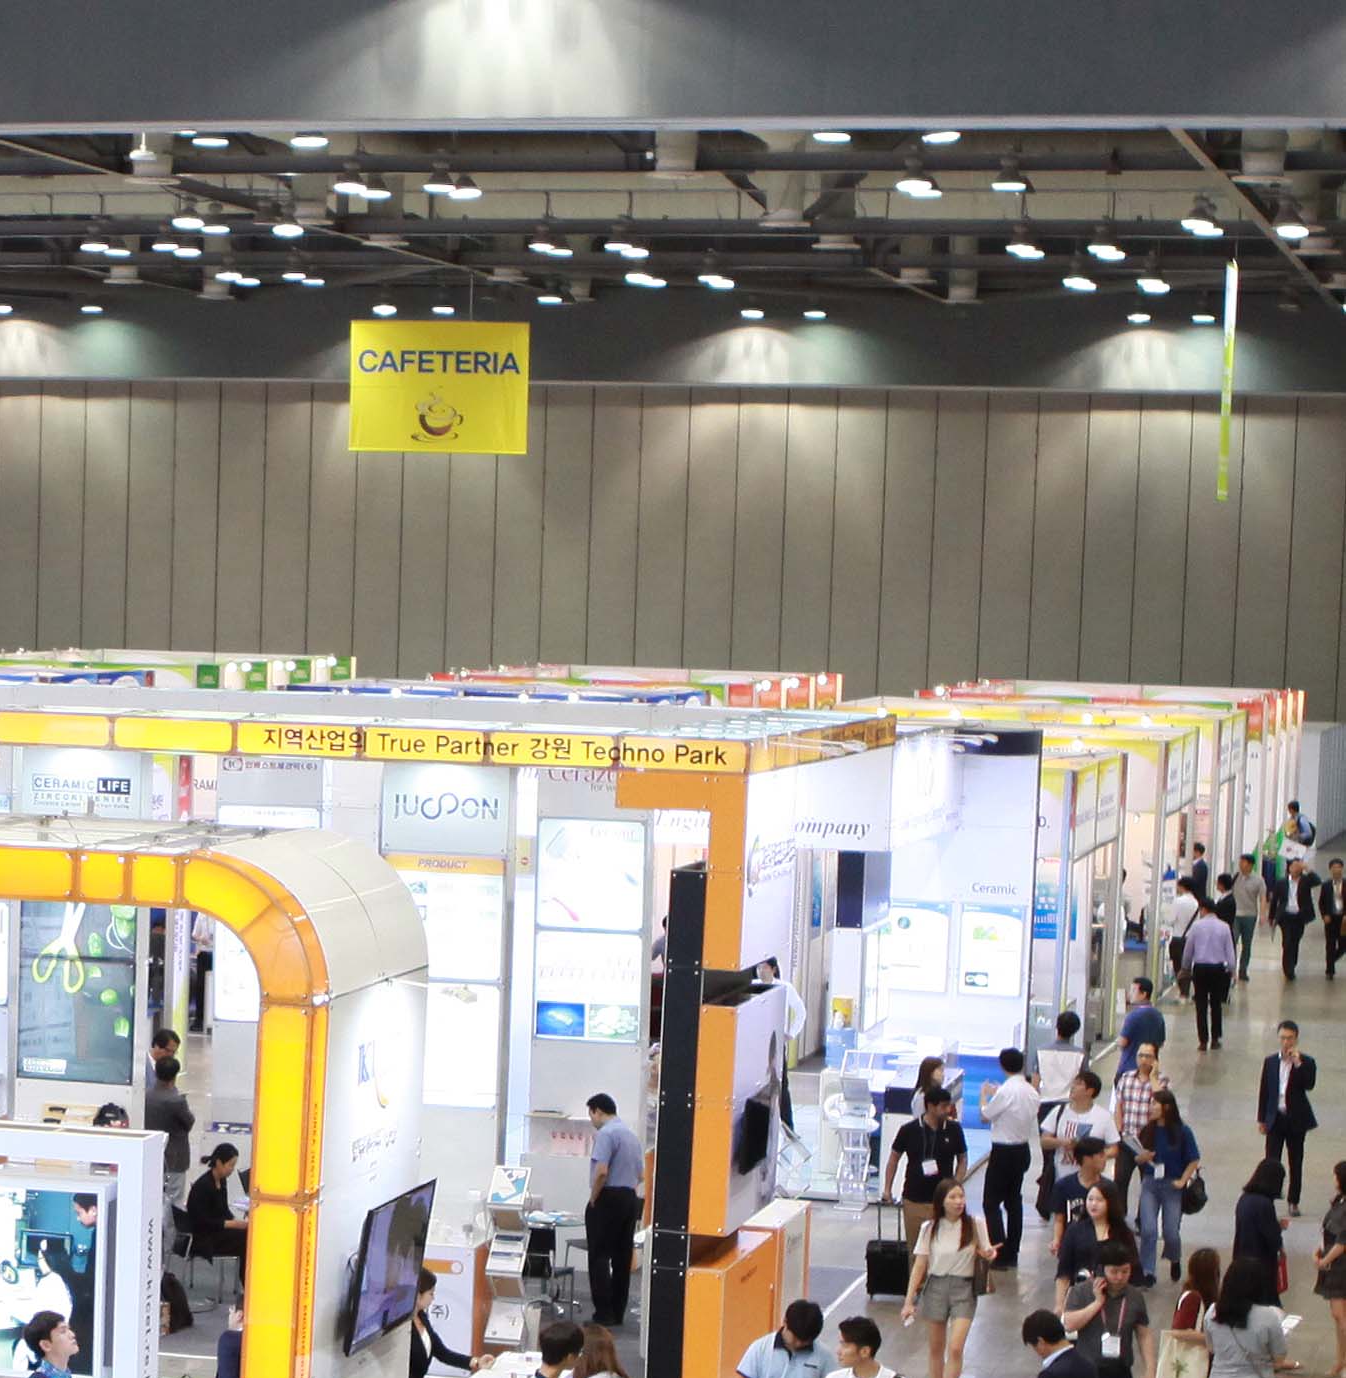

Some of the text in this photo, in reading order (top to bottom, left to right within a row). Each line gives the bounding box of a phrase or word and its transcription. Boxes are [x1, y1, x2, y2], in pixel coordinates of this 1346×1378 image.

[358, 349, 521, 377] CAFETERIA
[264, 728, 727, 766] 지역산업의 True Partner 강원 Techno Park
[34, 776, 130, 793] CERAMIC LIFE
[793, 816, 871, 840] ompany
[418, 858, 468, 869] PRODUCT
[972, 881, 1018, 897] Ceramic
